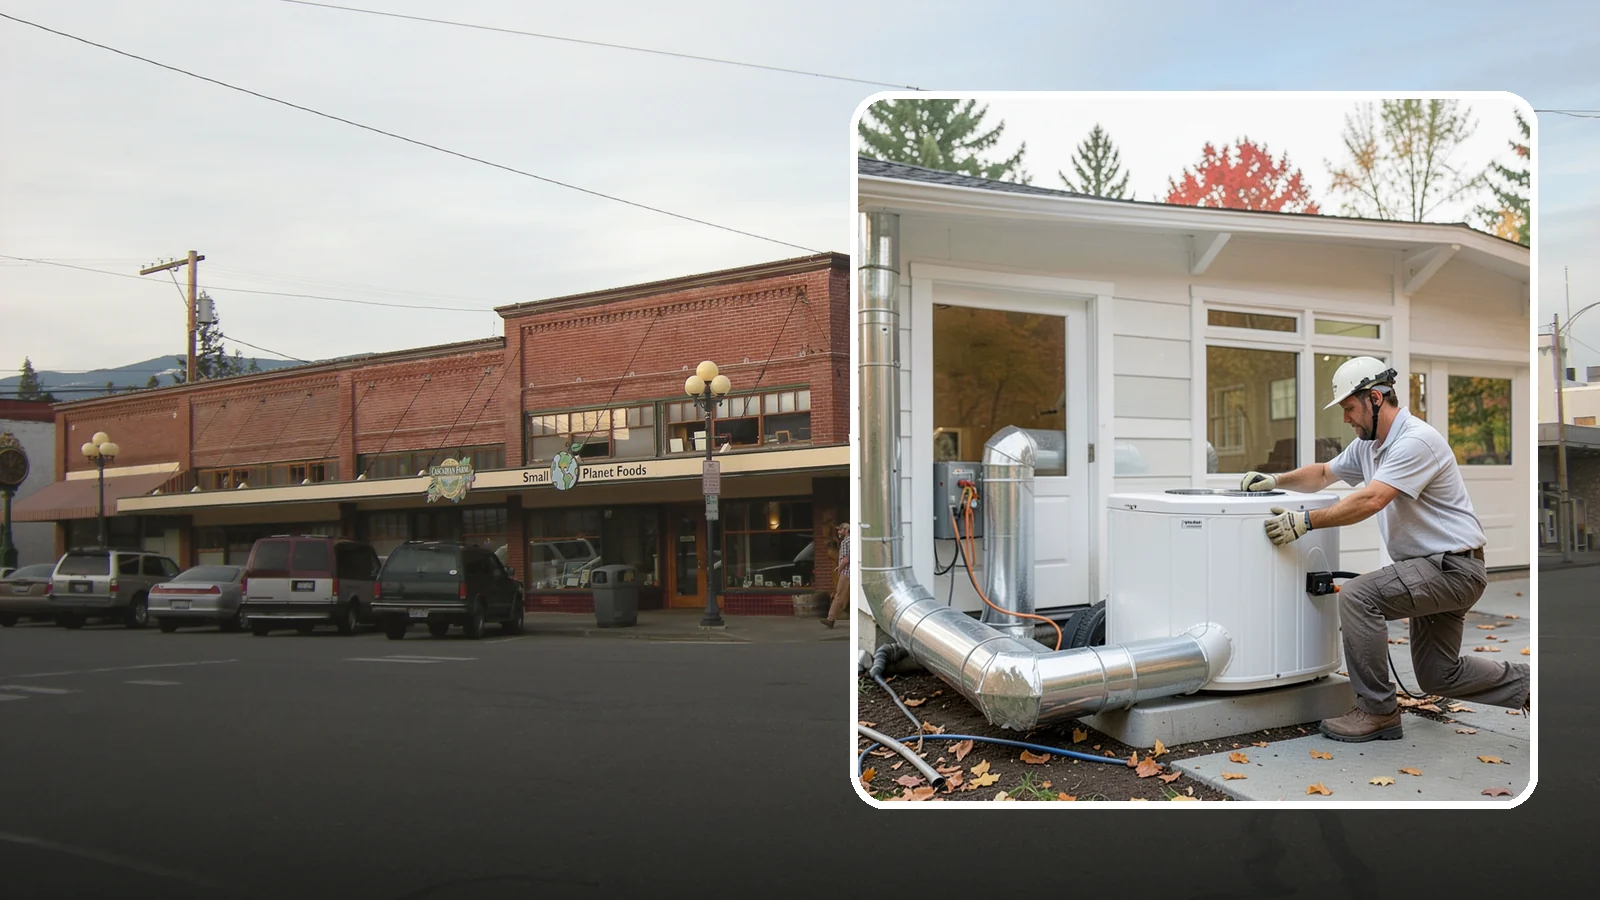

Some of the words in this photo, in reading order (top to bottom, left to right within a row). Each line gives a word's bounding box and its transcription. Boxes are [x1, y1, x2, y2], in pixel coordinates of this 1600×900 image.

[523, 471, 548, 482] Small
[583, 468, 614, 478] Planet
[617, 465, 646, 476] Foods
